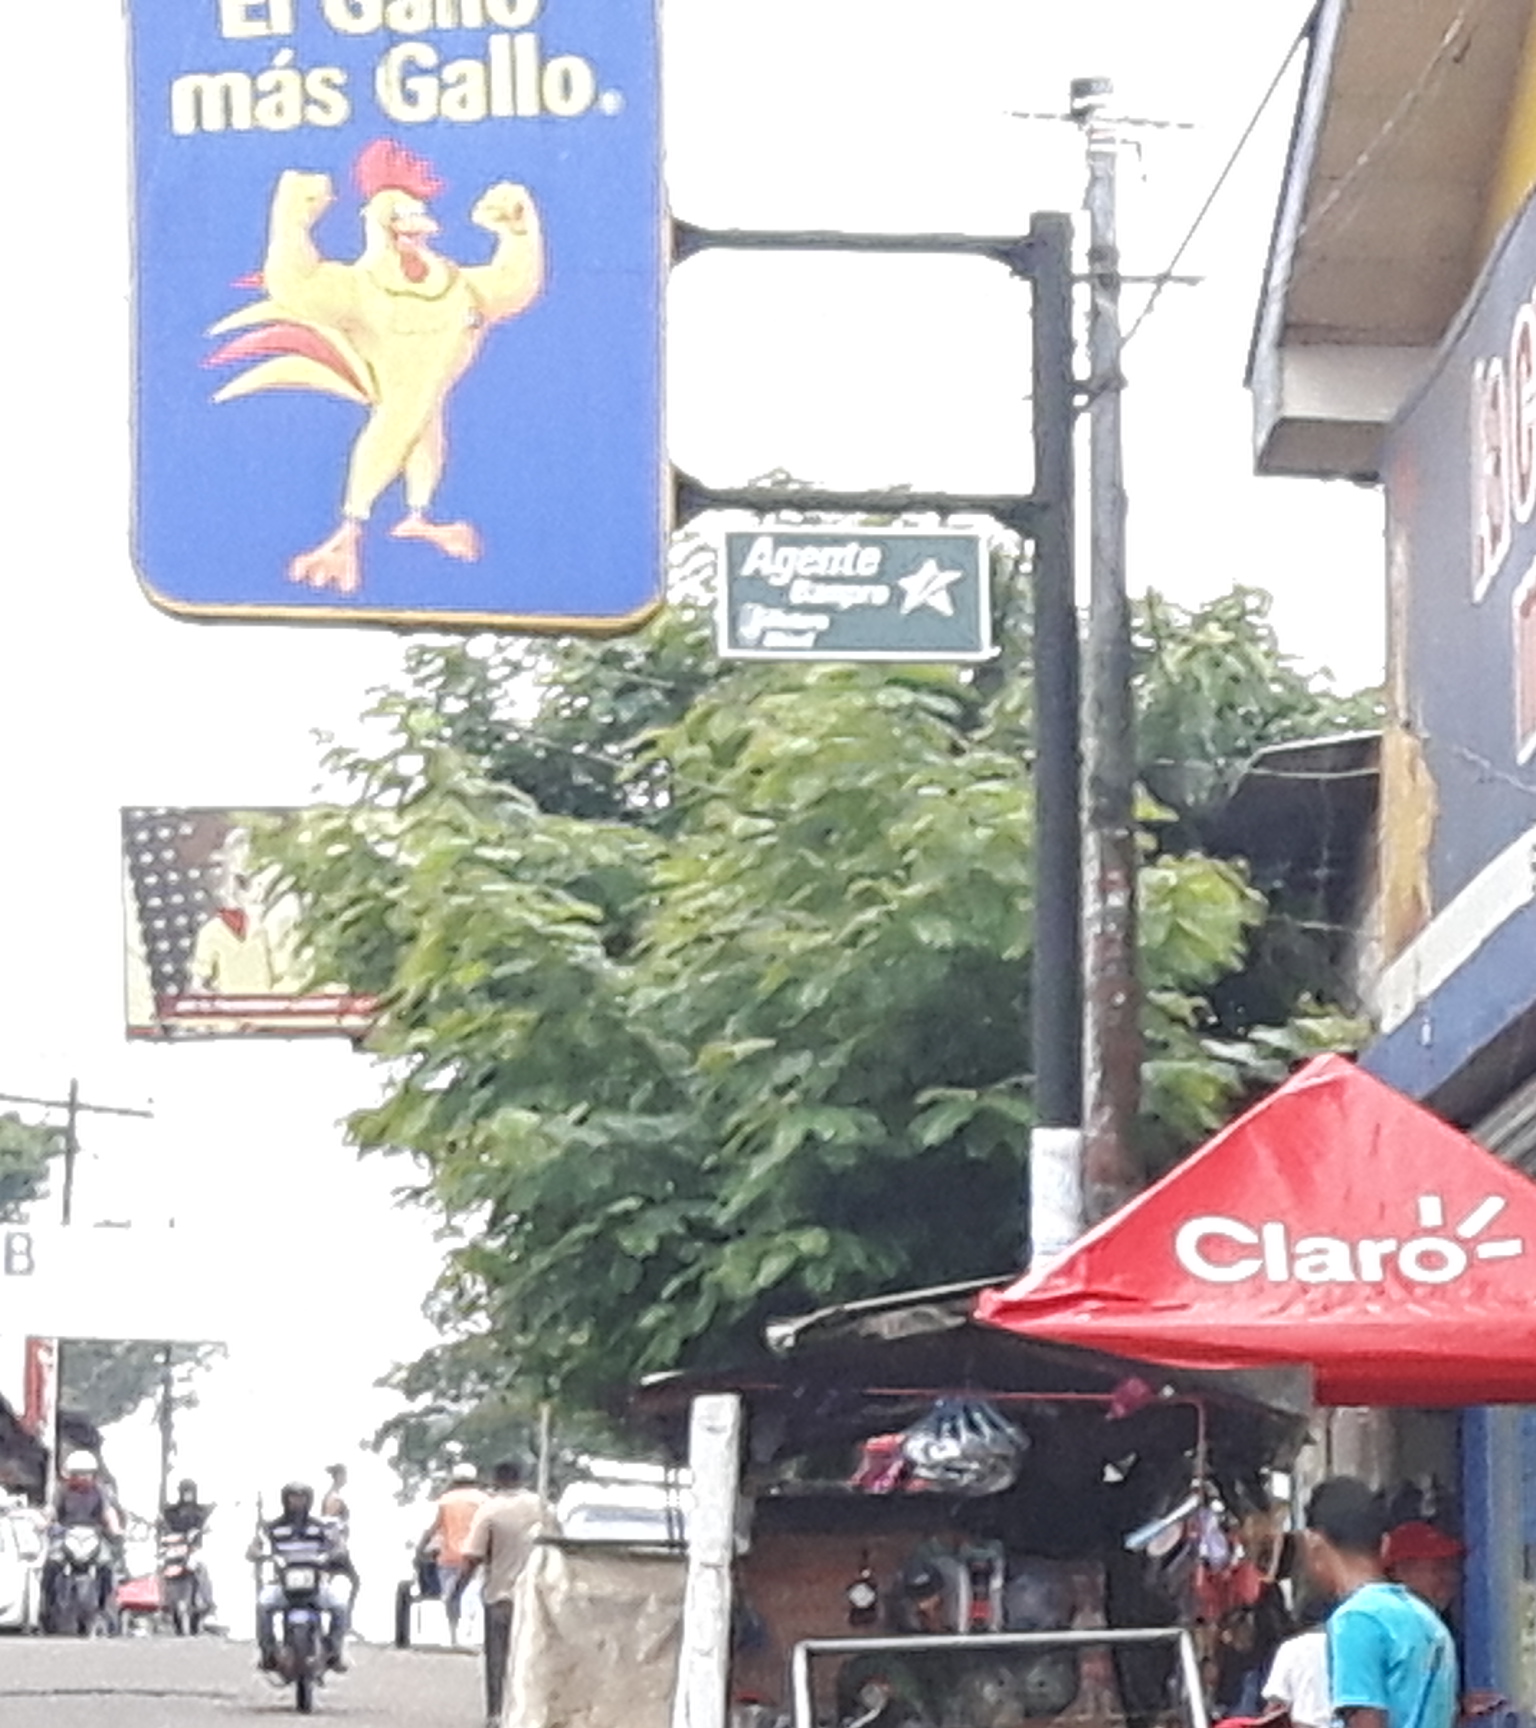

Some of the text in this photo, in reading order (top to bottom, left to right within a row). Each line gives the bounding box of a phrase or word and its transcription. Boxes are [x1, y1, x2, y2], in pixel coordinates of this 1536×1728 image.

[170, 32, 625, 136] más Gallo.
[740, 536, 882, 586] Agente
[1174, 1214, 1469, 1285] Claro
